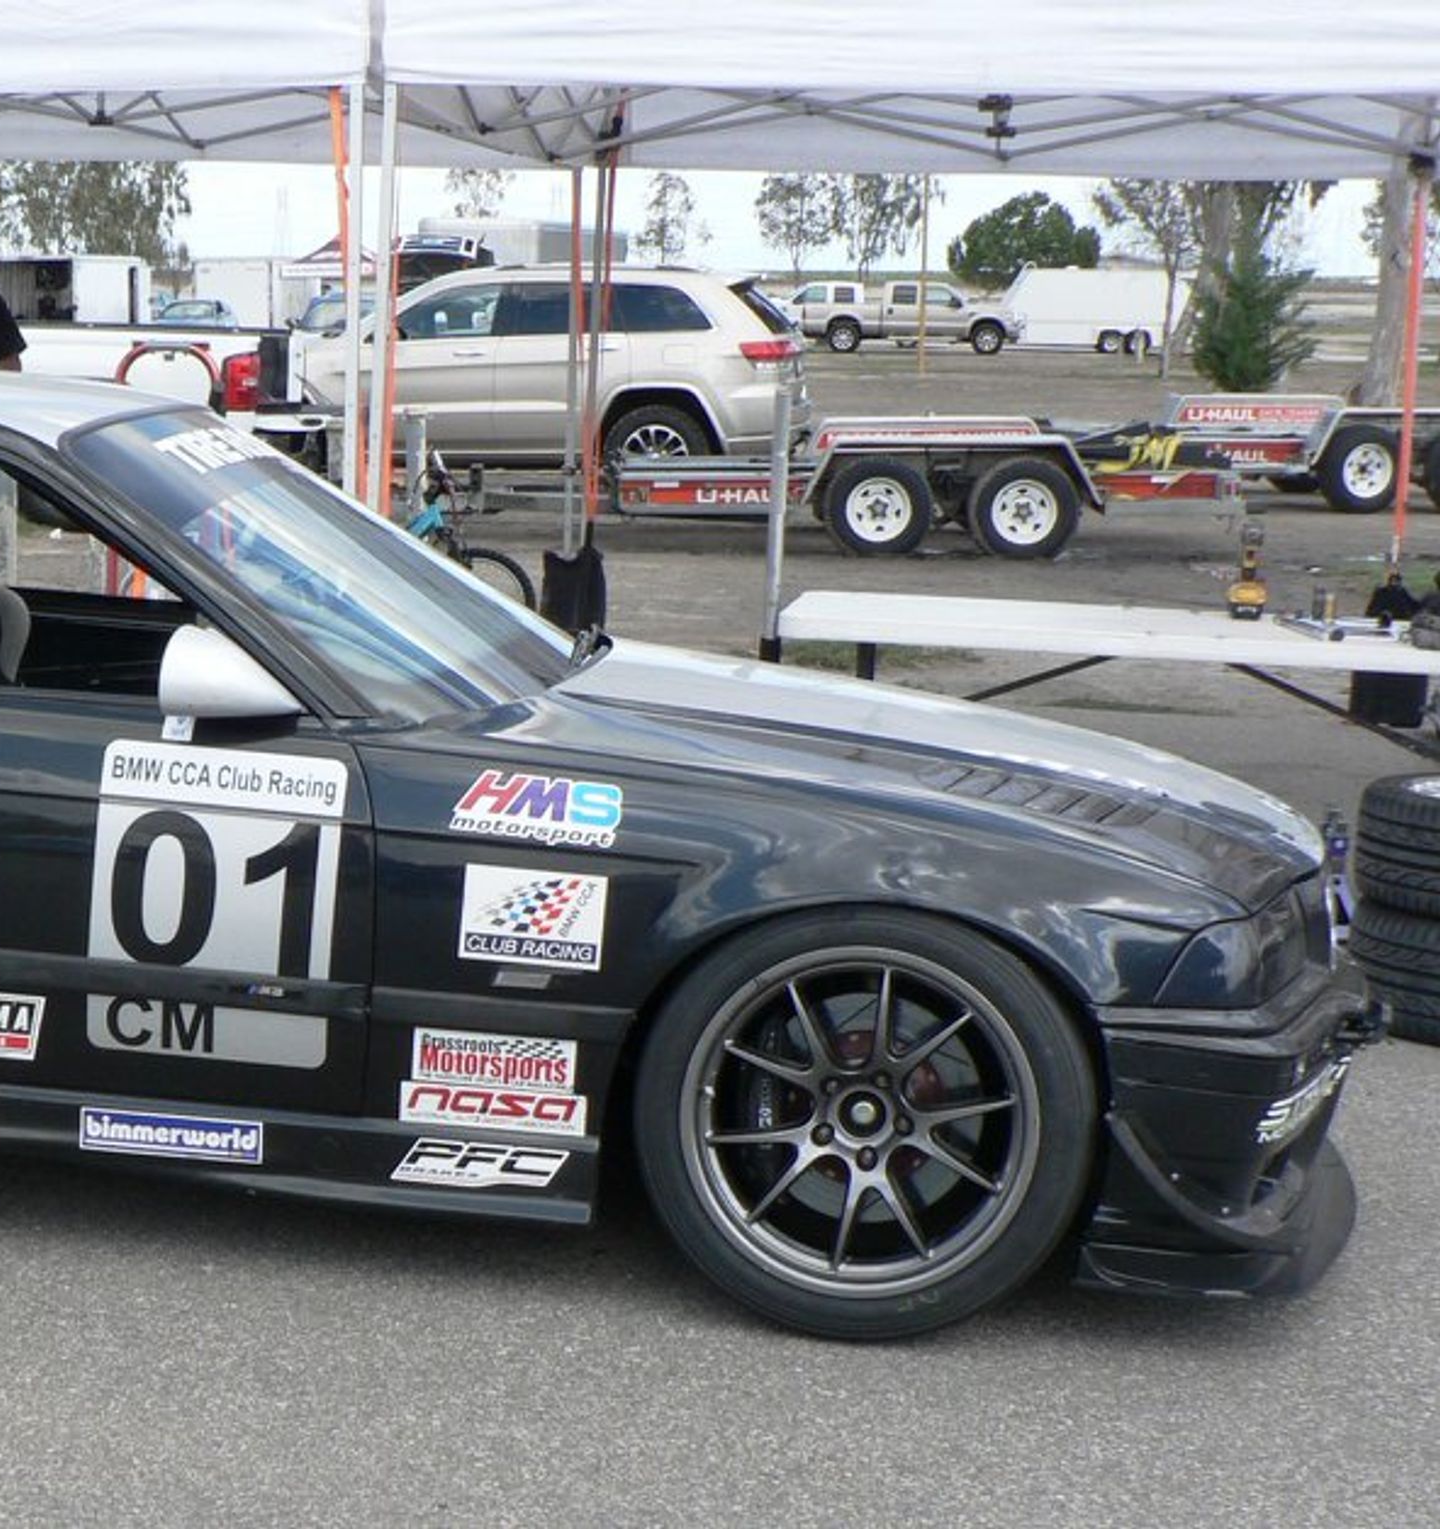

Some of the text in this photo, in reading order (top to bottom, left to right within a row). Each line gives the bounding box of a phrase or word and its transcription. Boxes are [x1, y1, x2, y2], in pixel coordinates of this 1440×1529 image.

[112, 754, 338, 806] BMW CCA Club Racing
[457, 771, 622, 828] HMS
[451, 815, 615, 846] motorsport
[111, 809, 321, 980] 01
[466, 934, 593, 961] CLUB RACING
[106, 996, 215, 1053] CM
[421, 1032, 502, 1055] Grassroots
[419, 1043, 568, 1084] Motorsports
[85, 1114, 259, 1151] bimmerworld
[405, 1141, 566, 1178] PFC
